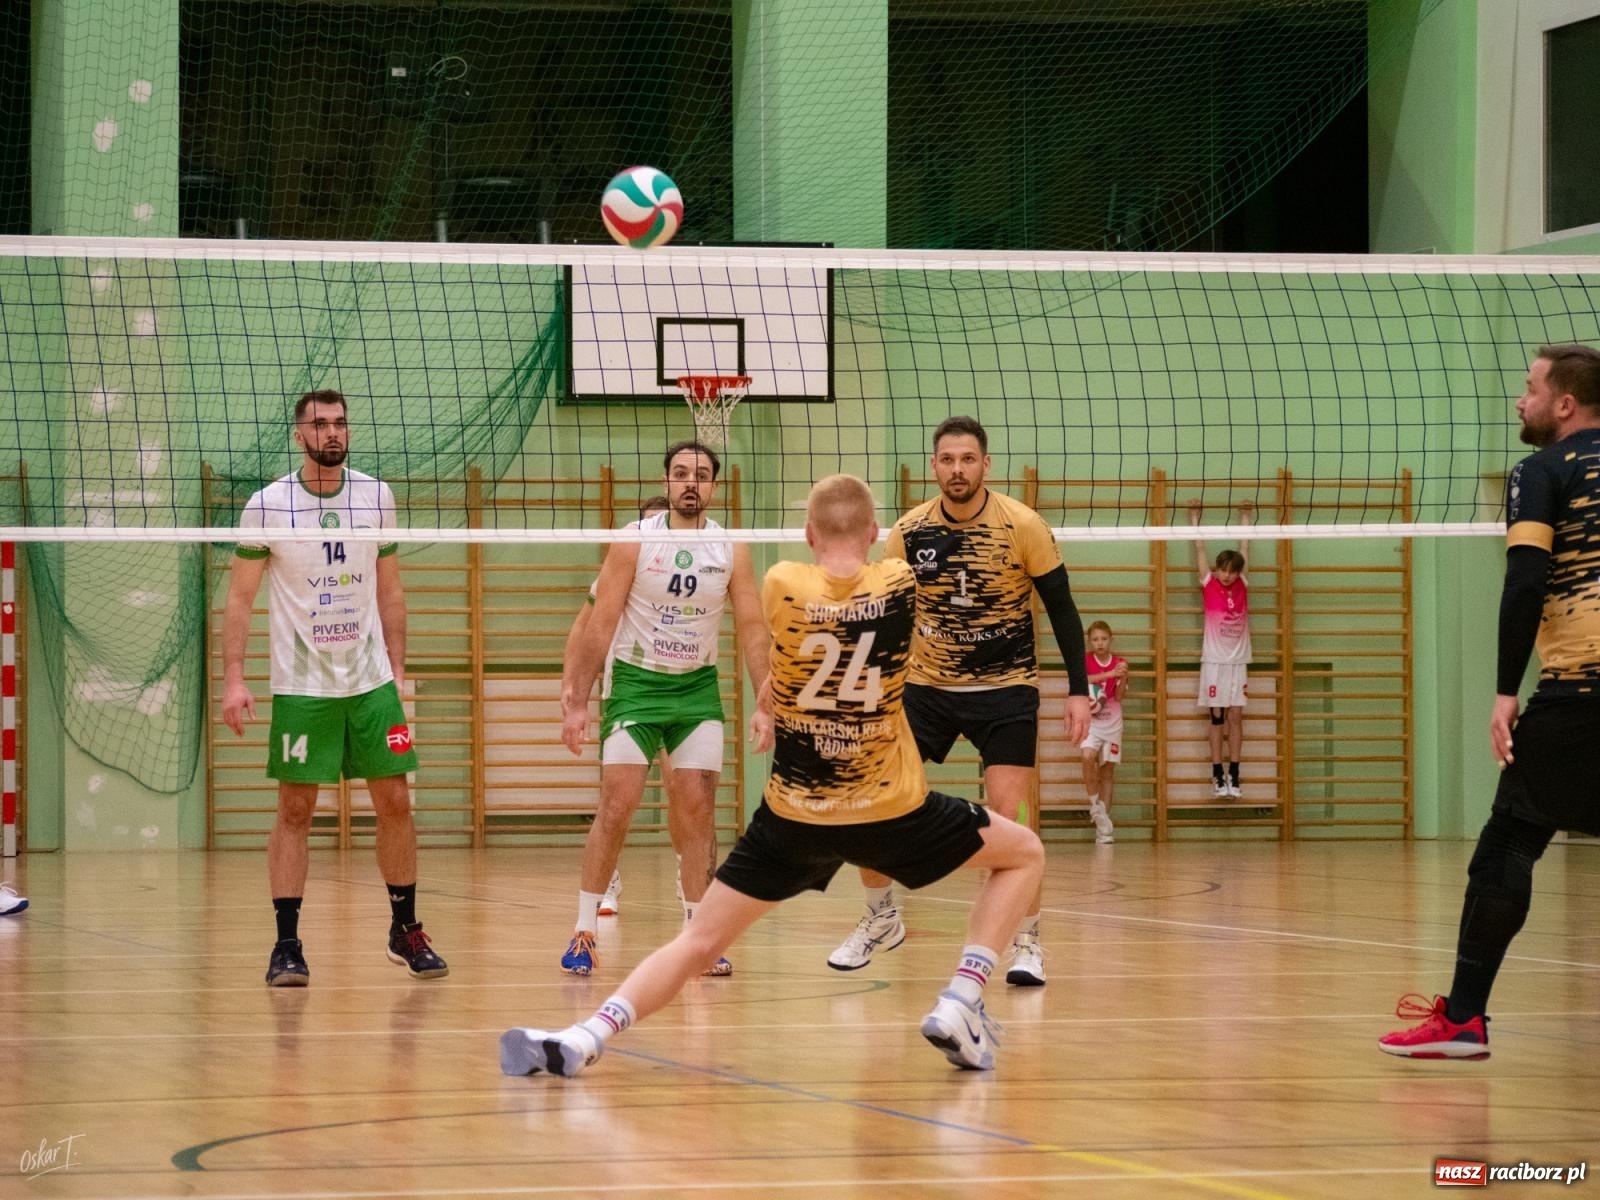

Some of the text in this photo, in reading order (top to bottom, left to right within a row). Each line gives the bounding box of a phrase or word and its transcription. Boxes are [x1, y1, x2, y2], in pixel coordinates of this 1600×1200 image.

[322, 541, 347, 566] 14
[307, 573, 362, 588] VISON
[667, 573, 698, 598] 49
[803, 599, 887, 622] SHUMAKOV
[312, 621, 360, 636] PIVEXIN
[959, 631, 992, 642] KOKS
[312, 633, 360, 644] TECHNOLOGY
[653, 639, 699, 654] PIVEXIN
[654, 648, 699, 660] TECHNOLOGY
[796, 631, 884, 713] 24
[282, 733, 308, 764] 14
[813, 735, 861, 756] RADLIN
